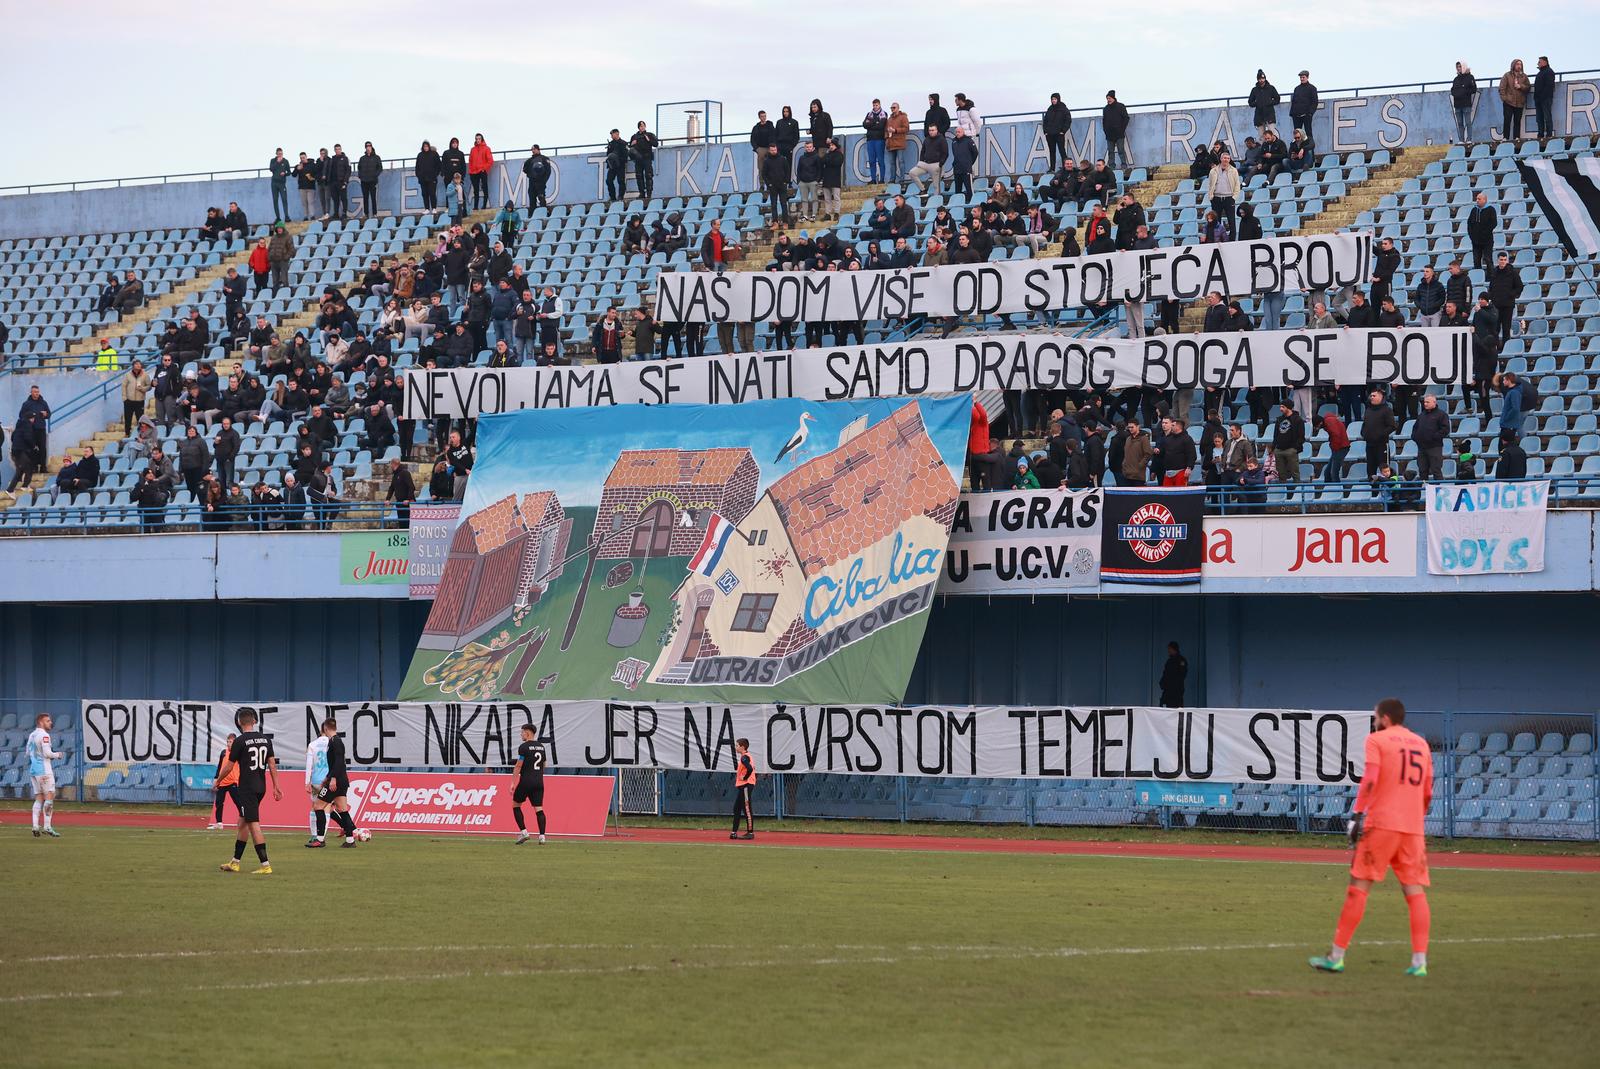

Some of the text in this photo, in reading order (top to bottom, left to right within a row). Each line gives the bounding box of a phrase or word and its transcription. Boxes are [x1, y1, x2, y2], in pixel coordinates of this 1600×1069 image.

[656, 235, 1372, 322] NAŠ DOM VIŠE OD STOLJEĆA BROJI
[708, 353, 793, 405] INATI
[825, 346, 929, 399] SAMO
[954, 340, 1116, 391] DRAGOG
[1142, 337, 1254, 389] BOGA
[1282, 333, 1338, 387] SE
[1366, 331, 1468, 385] BOJI
[1132, 505, 1172, 525] CIBALIA
[387, 533, 410, 547] 182
[412, 525, 448, 539] PONOS
[1123, 526, 1182, 539] IZNAD SVIH
[1134, 540, 1173, 560] VINKOVCI
[803, 531, 942, 630] Cibalia
[690, 583, 932, 683] ULTRAS VINKOVCI
[85, 701, 212, 763] SRUŠITI
[424, 703, 558, 766] NIKADA
[585, 703, 659, 767] JER
[683, 706, 738, 770] NA
[766, 704, 977, 776] ČVRSTOM
[1008, 708, 1215, 780] TEMELJU
[247, 745, 268, 771] 30
[533, 751, 542, 770] 2
[1399, 748, 1423, 786] 15
[370, 780, 498, 811] SuperSport
[361, 811, 492, 825] PRVA NOGOMETNA LIGA
